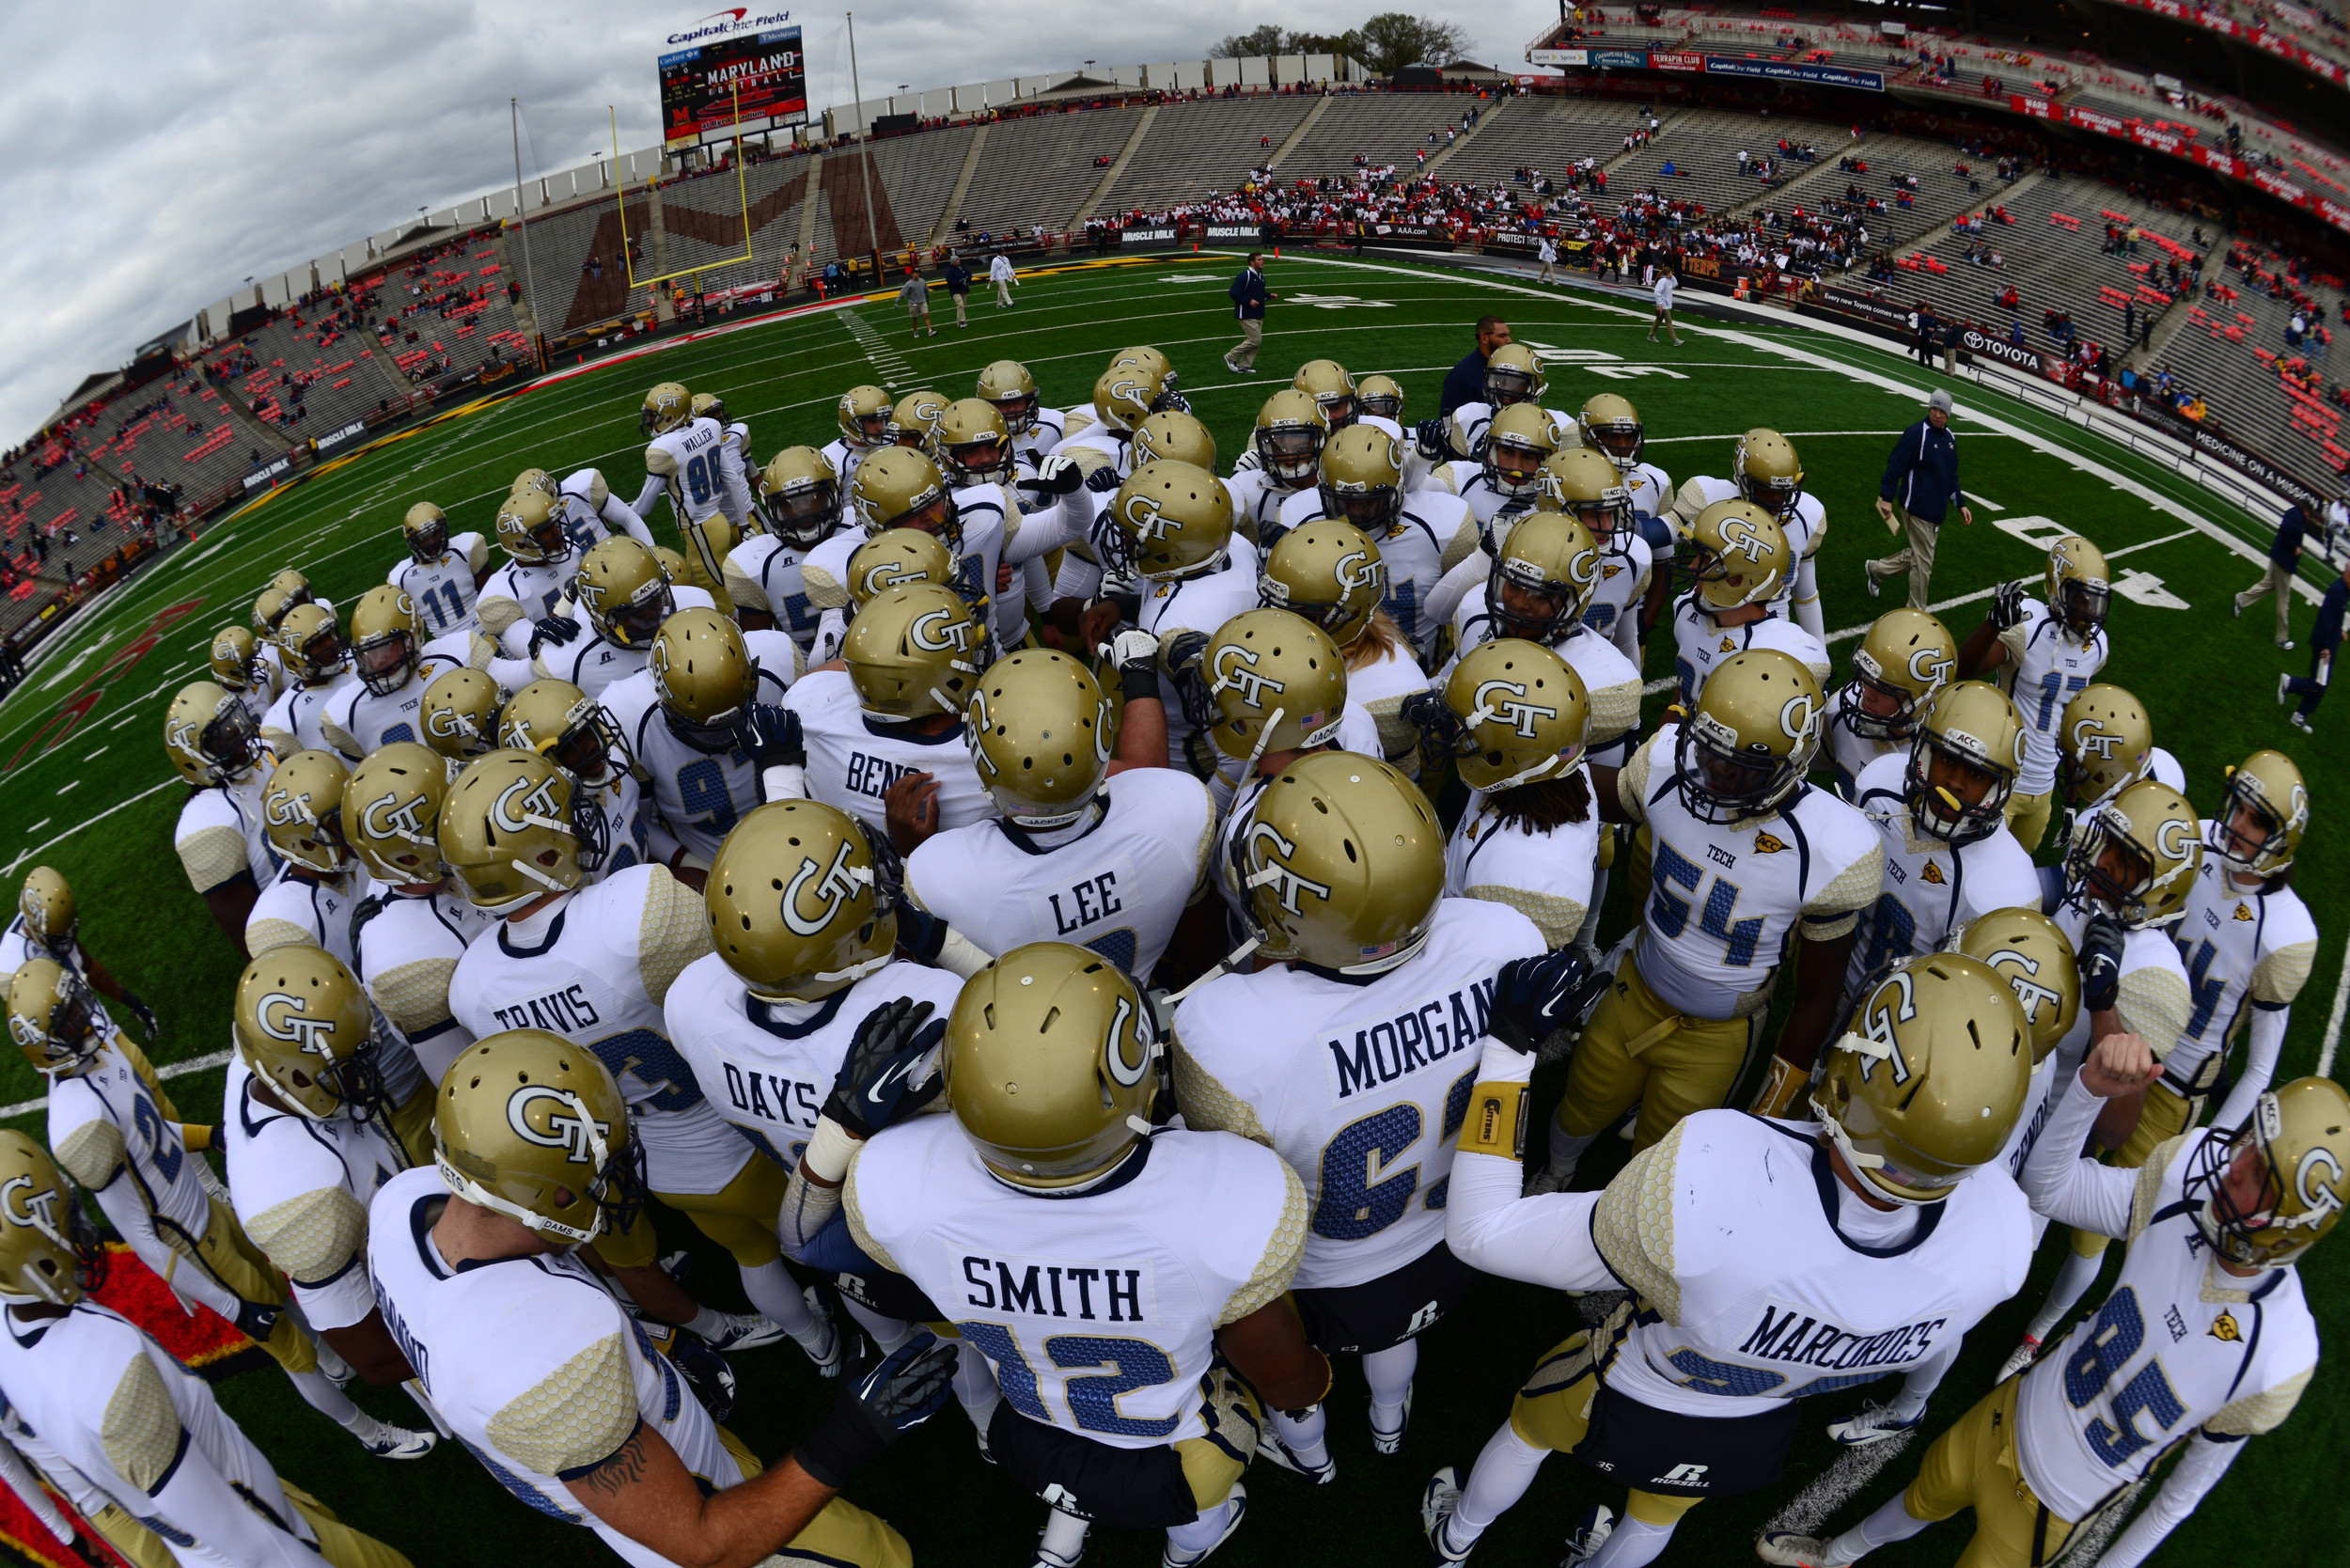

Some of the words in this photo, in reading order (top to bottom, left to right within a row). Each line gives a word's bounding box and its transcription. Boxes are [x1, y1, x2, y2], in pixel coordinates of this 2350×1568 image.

[755, 11, 789, 26] Field
[707, 51, 795, 85] MARYLAND
[1534, 53, 1550, 61] Sprint
[1560, 54, 1576, 62] Sprint
[1653, 54, 1683, 64] TERRAPIN
[1684, 55, 1700, 65] CLUB
[1802, 71, 1818, 79] Field
[1860, 78, 1877, 86] Field
[701, 120, 711, 130] at
[712, 117, 730, 128] Byrd
[1122, 231, 1154, 243] MUSCLE
[1154, 229, 1175, 240] MILK
[1207, 227, 1239, 237] MUSCLE
[1240, 227, 1260, 237] MILK
[1397, 227, 1428, 236] AAA.com
[1496, 232, 1526, 244] PROTECT
[1527, 236, 1538, 245] THIS
[1688, 258, 1720, 278] TERPS
[696, 297, 705, 324] ACC
[1824, 292, 1840, 304] Every
[1854, 300, 1872, 314] Toyota
[1873, 307, 1892, 319] comes
[1892, 311, 1906, 321] with
[1983, 337, 2039, 370] TOYOTA
[317, 430, 345, 450] MUSCLE
[345, 420, 365, 438] MILK
[682, 427, 714, 454] WALLER
[1508, 432, 1523, 442] ACC
[243, 467, 271, 489] MUSCLE
[270, 457, 290, 476] MILK
[2196, 431, 2248, 466] MEDICINE
[2248, 460, 2264, 477] ON
[2265, 471, 2276, 484] A
[2275, 476, 2320, 510] MISSION
[917, 488, 937, 503] ACC
[1609, 488, 1621, 497] ACC
[1124, 494, 1183, 542] GT
[1717, 516, 1775, 564] GT
[428, 573, 441, 584] TECH
[1334, 551, 1385, 592] GT
[1516, 561, 1533, 574] ACC
[1603, 566, 1618, 575] ACC
[638, 582, 653, 594] ACC
[1267, 581, 1281, 592] ACC
[421, 578, 466, 629] 11
[911, 609, 973, 655] GT
[1697, 647, 1712, 665] TECH
[1721, 640, 1733, 652] ACC
[1861, 656, 1874, 668] ACC
[1908, 649, 1954, 687] GT
[1213, 644, 1287, 709] GT
[400, 698, 418, 713] TECH
[571, 700, 587, 714] ACC
[1474, 680, 1557, 739] GT
[1706, 721, 1726, 735] ACC
[1958, 733, 1976, 745] ACC
[2073, 718, 2124, 761] GT
[846, 751, 923, 800] BEN
[2245, 776, 2257, 788] ACC
[363, 792, 428, 841] GT
[494, 775, 561, 835] GT
[2109, 811, 2123, 823] ACC
[611, 812, 624, 833] TECH
[1758, 833, 1780, 852] ACC
[1707, 844, 1736, 870] TECH
[1888, 857, 1907, 886] TECH
[1924, 865, 1941, 883] ACC
[780, 838, 863, 938] GT
[1049, 870, 1122, 935] LEE
[1651, 836, 1768, 968] 54
[2203, 907, 2221, 931] TECH
[256, 992, 336, 1055] GT
[1328, 977, 1496, 1099] MORGAN
[723, 1061, 821, 1129] DAYS
[507, 1084, 611, 1165] GT
[1480, 1098, 1501, 1143] CUTTERS
[963, 1256, 1144, 1322] SMITH
[2163, 1304, 2188, 1344] TECH
[1738, 1305, 1947, 1371] MARCORDES
[953, 1319, 1183, 1439] 12
[2064, 1284, 2191, 1469] 85
[1651, 1477, 1711, 1489] RUSSELL
[1664, 1463, 1710, 1481] R
